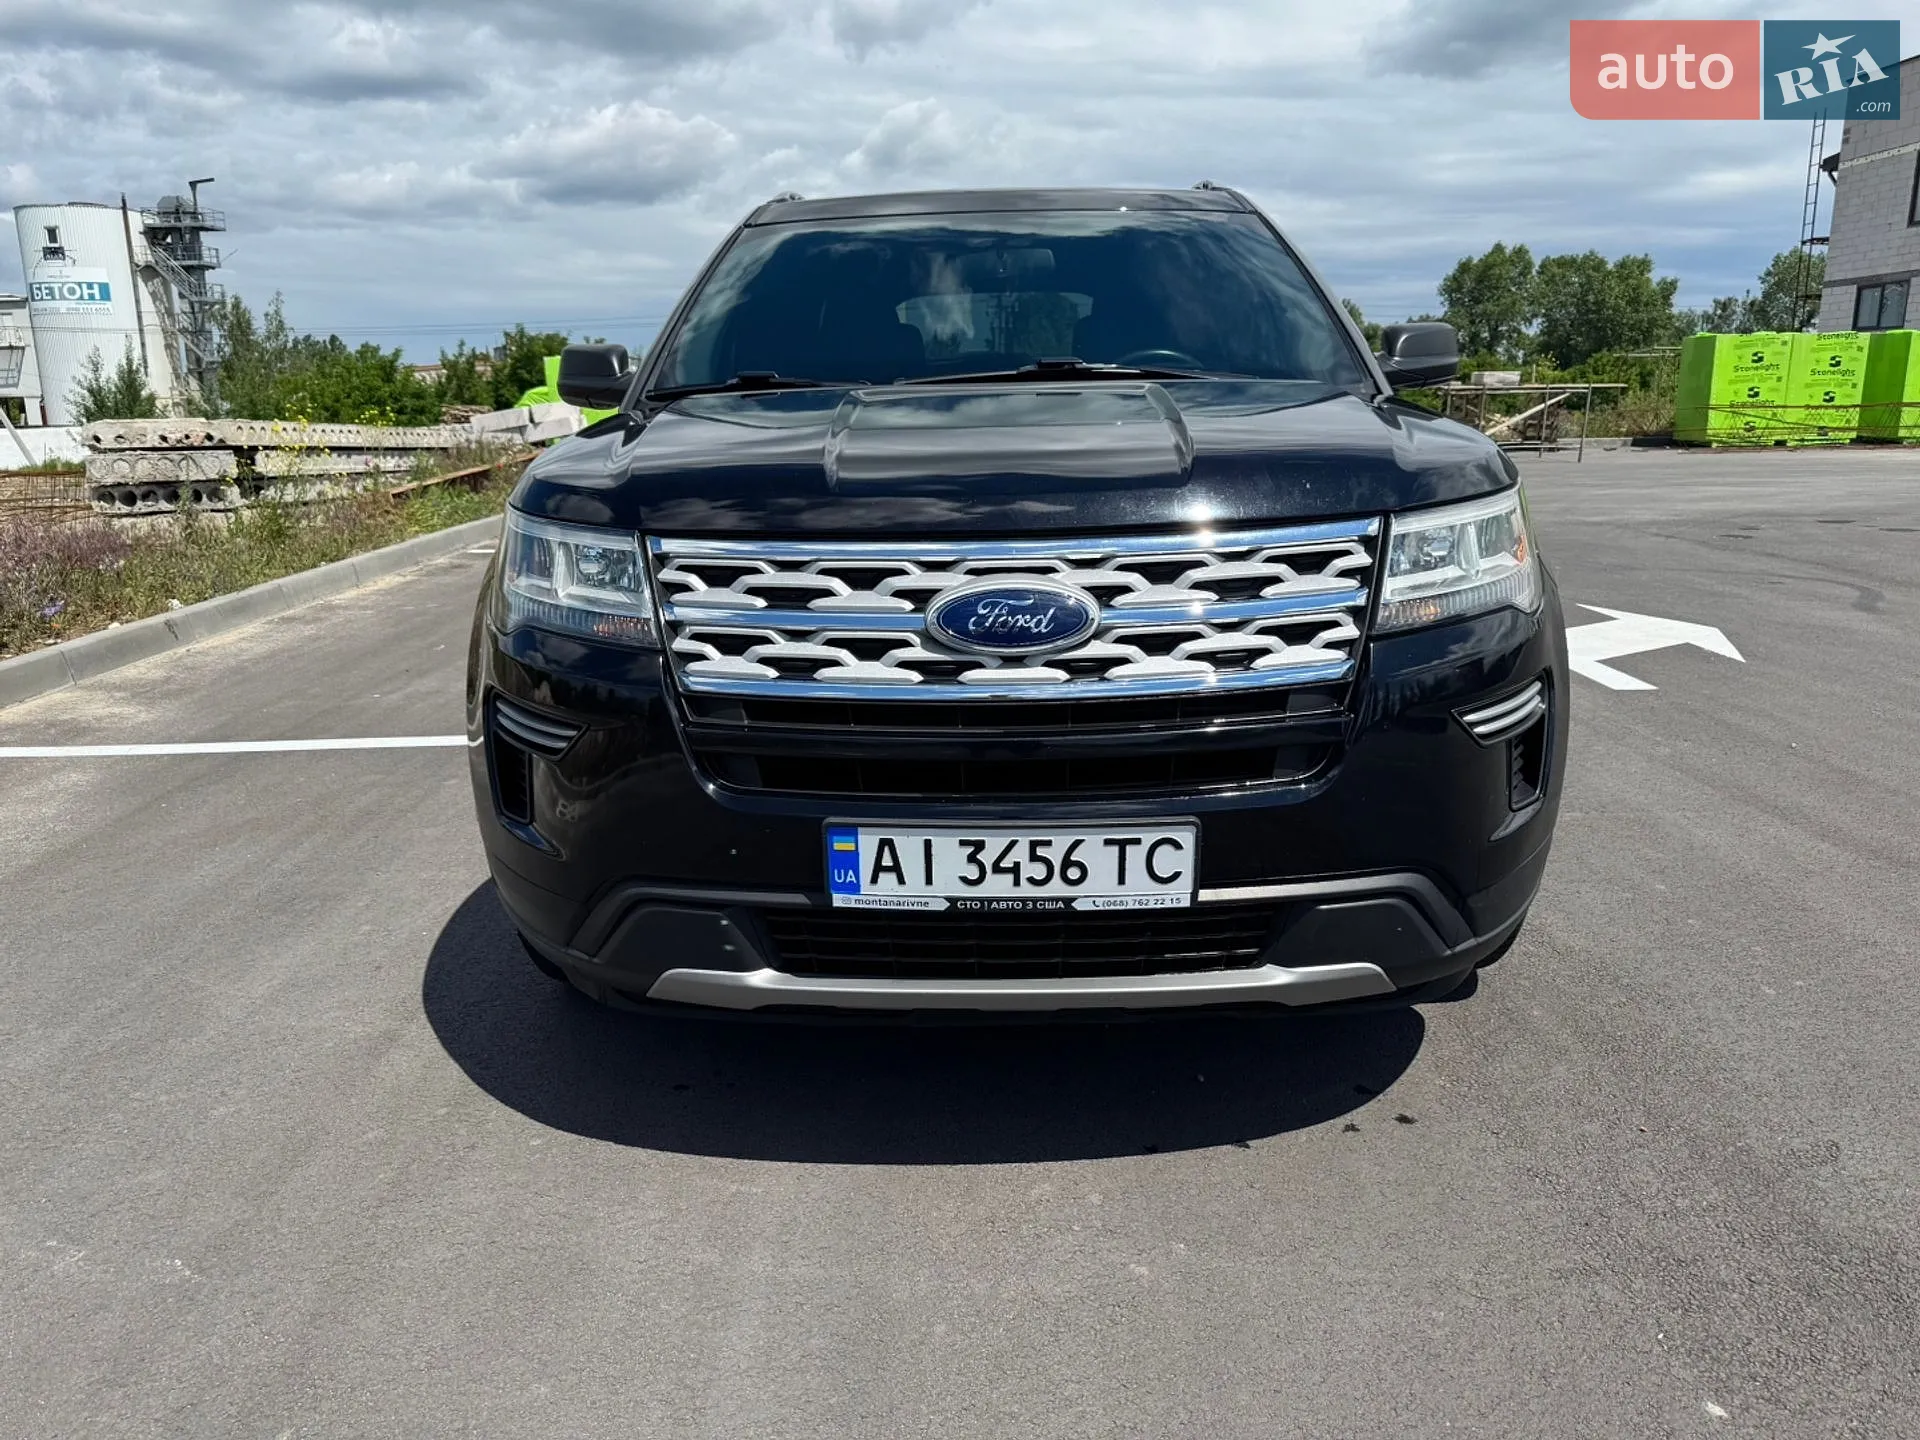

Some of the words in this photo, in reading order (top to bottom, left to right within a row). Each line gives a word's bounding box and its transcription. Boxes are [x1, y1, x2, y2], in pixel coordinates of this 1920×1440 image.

[32, 283, 101, 300] БЕТОН
[1733, 363, 1780, 373] Stonelight
[1809, 368, 1856, 378] Stonelight
[967, 593, 1057, 635] Ford
[869, 837, 935, 886] AI
[957, 837, 1089, 888] 3456
[1103, 836, 1185, 887] TC
[834, 868, 858, 885] UA
[854, 897, 930, 909] montanarivne
[956, 900, 982, 910] СТО
[990, 900, 1023, 910] АВТО
[1036, 900, 1065, 910] США
[1131, 898, 1150, 907] 762
[1153, 898, 1166, 906] 22
